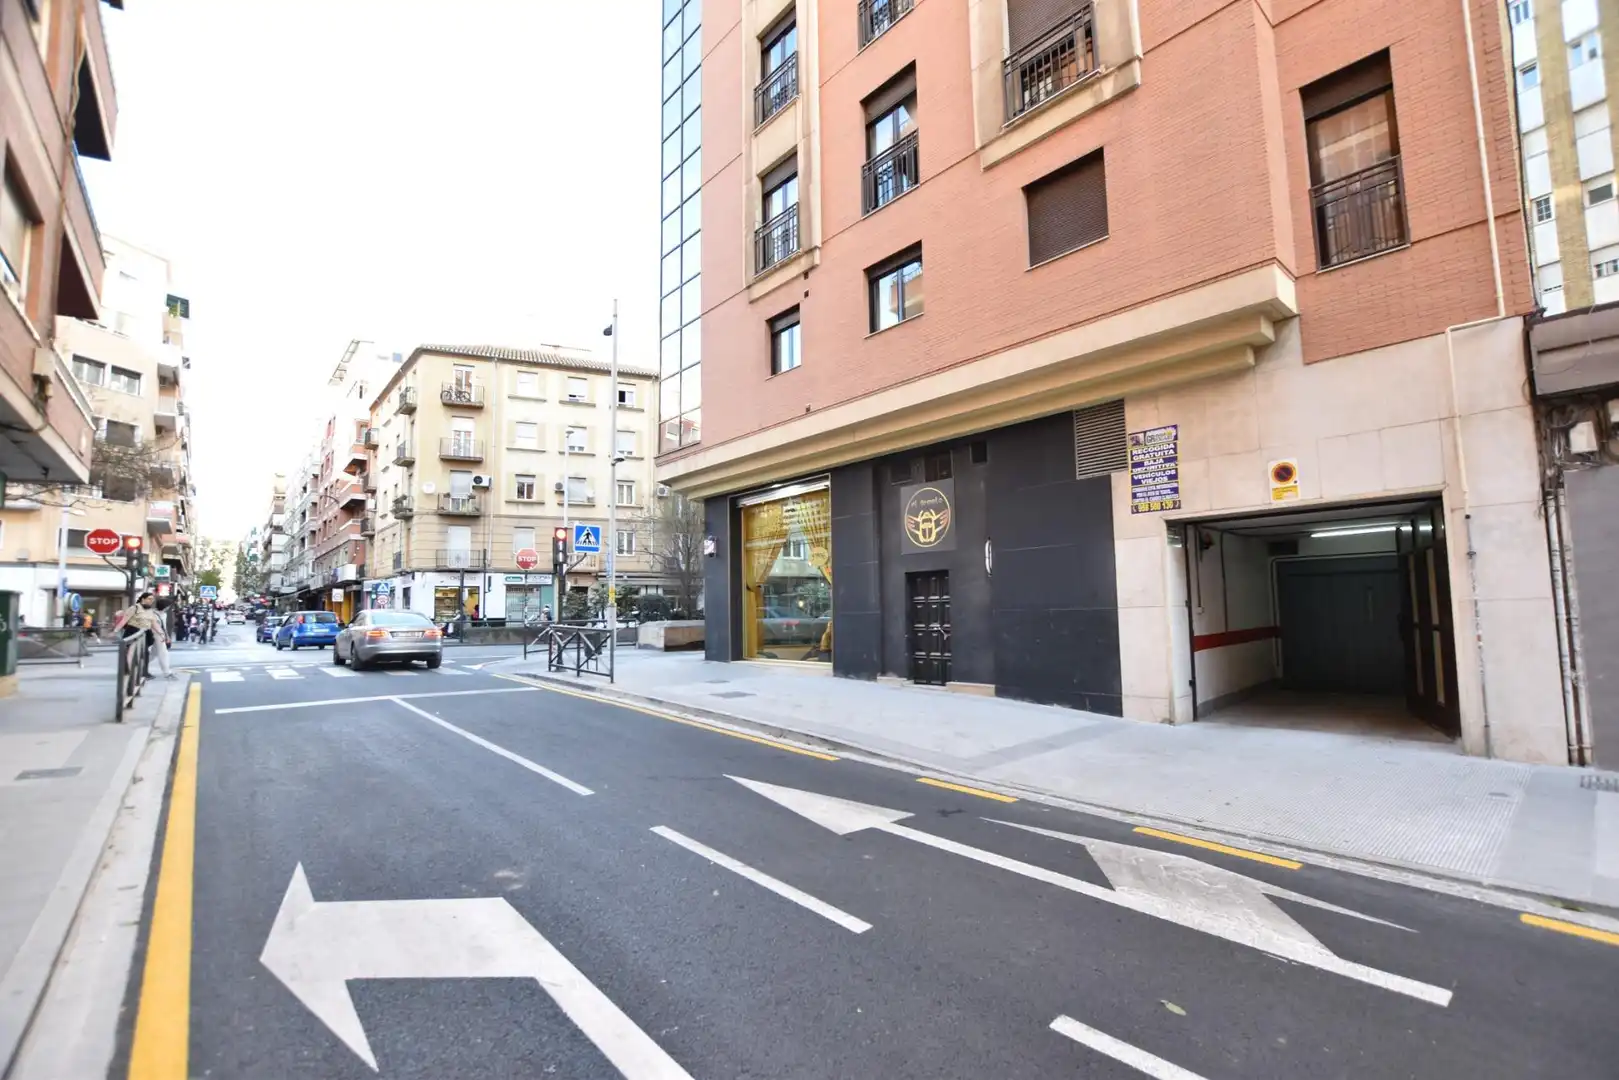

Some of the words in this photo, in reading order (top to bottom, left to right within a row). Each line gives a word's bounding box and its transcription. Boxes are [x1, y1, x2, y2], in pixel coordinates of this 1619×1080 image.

[1132, 443, 1175, 456] RECOGIDA
[1133, 449, 1175, 461] GRATUITA
[1144, 458, 1164, 467] BAJA
[1141, 475, 1169, 485] VIEJOS
[89, 537, 118, 545] STOP
